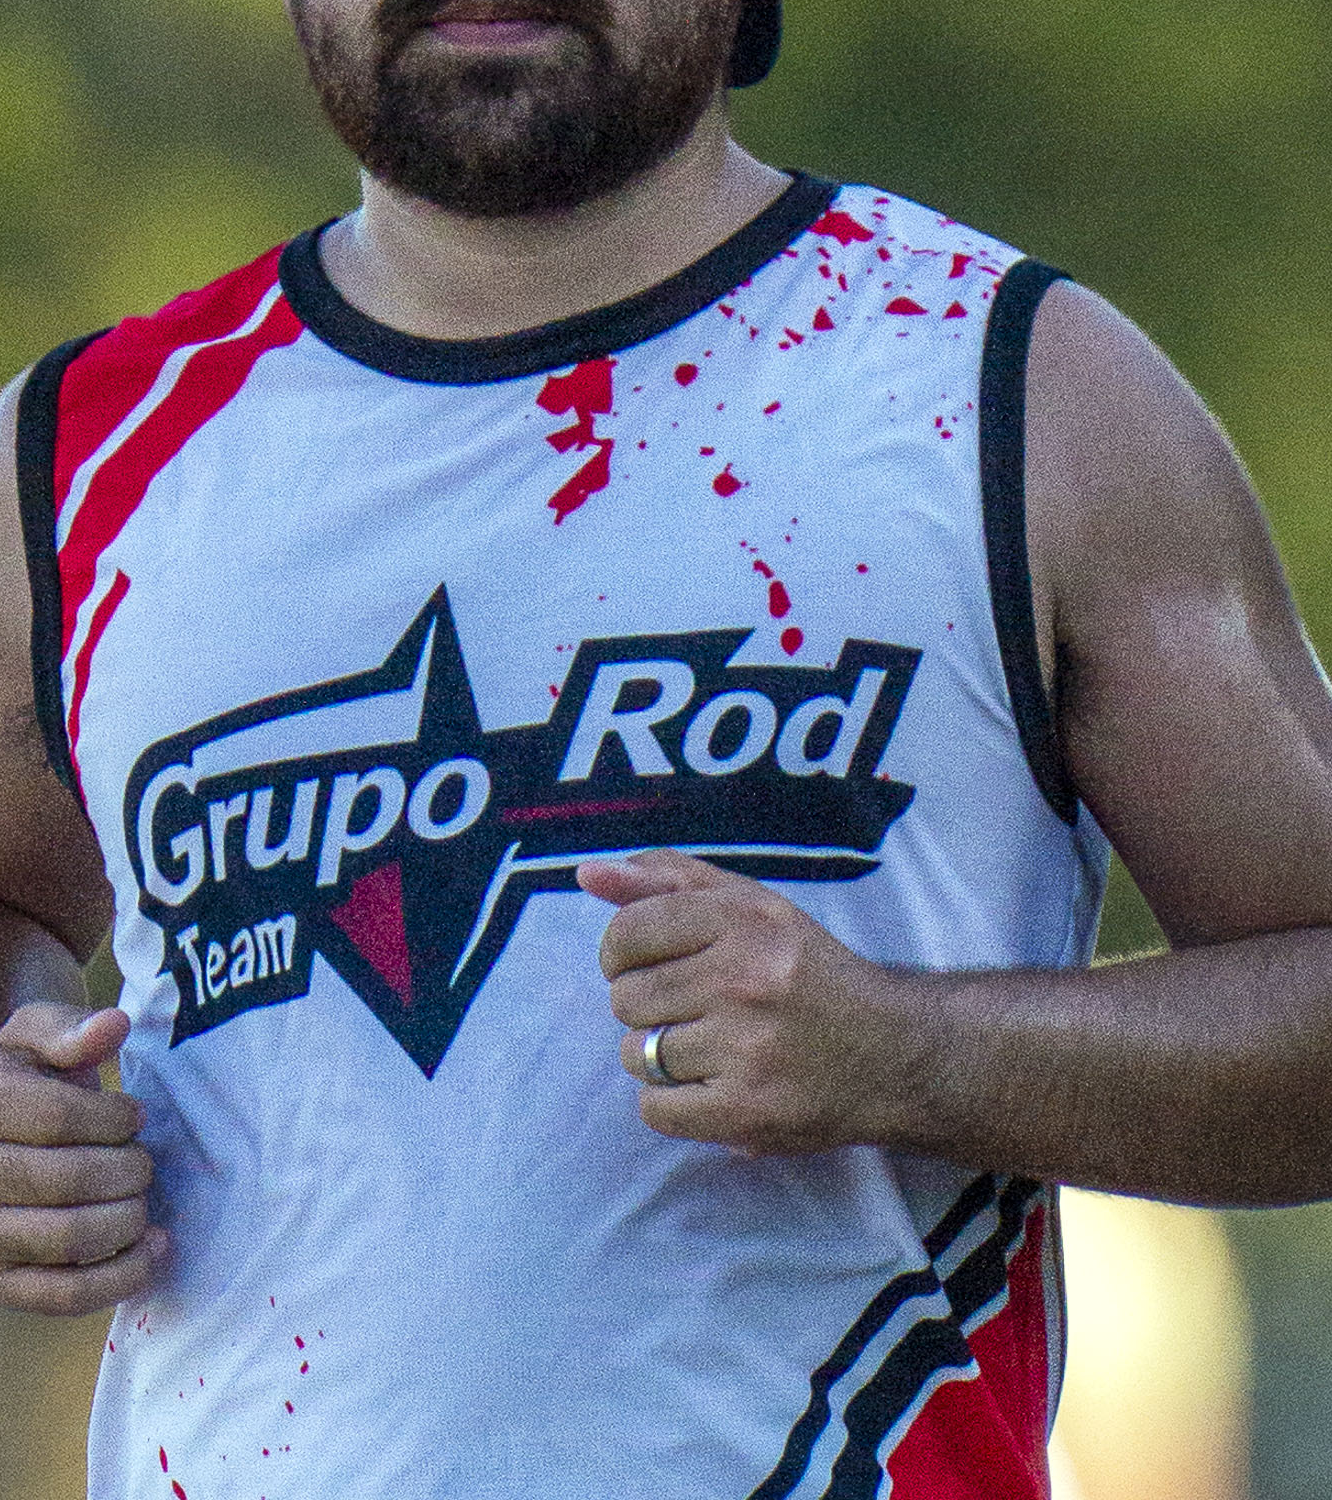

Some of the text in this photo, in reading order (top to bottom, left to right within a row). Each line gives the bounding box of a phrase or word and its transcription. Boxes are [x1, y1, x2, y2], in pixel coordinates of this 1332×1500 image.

[136, 658, 888, 906] Grupo Rod
[177, 910, 299, 1008] Team
